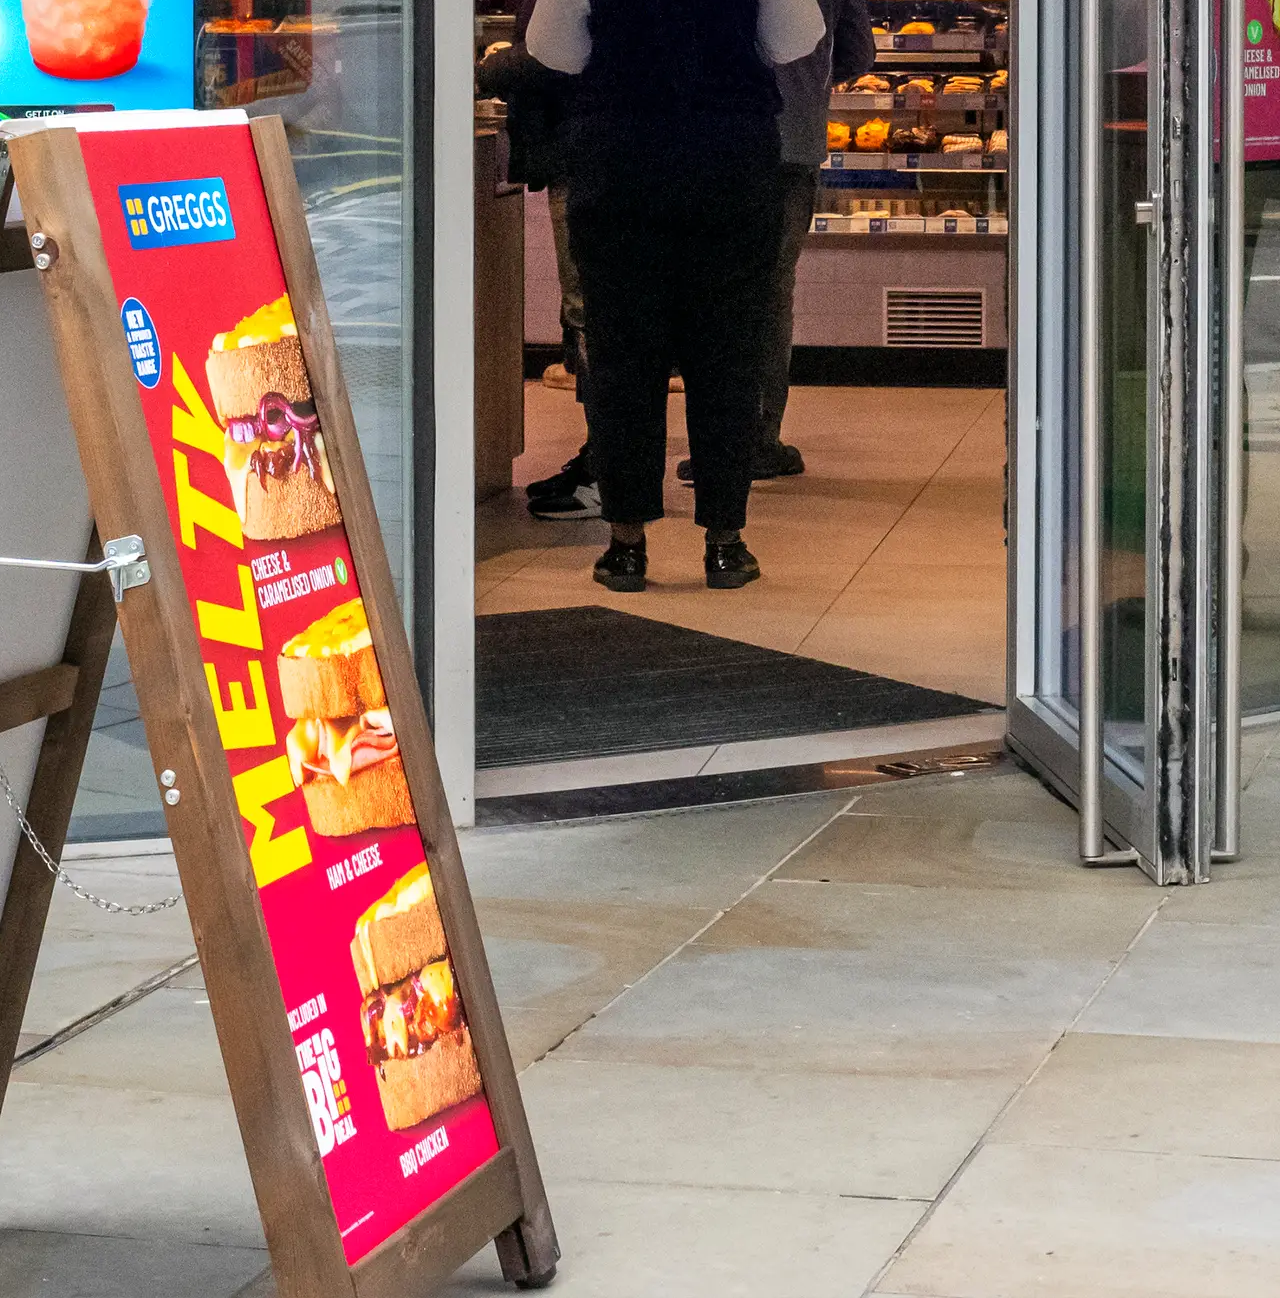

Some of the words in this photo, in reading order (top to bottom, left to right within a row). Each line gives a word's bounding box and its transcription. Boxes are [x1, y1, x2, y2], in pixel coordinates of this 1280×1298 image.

[1266, 50, 1272, 62] &
[147, 190, 227, 234] GREGGS
[126, 309, 144, 330] NEW
[251, 552, 283, 581] CHEESE
[281, 550, 291, 571] &
[258, 572, 311, 609] CARAMELISED
[309, 564, 336, 591] ONION
[172, 351, 313, 890] MELTY
[326, 862, 345, 891] HAM
[344, 857, 355, 874] &
[351, 843, 383, 879] CHEESE
[286, 996, 319, 1033] NCLUDED
[317, 993, 327, 1014] IN
[294, 1038, 317, 1072] THE
[301, 1027, 342, 1158] BIG
[333, 1114, 357, 1146] DEAL
[399, 1146, 419, 1179] BBQ
[415, 1125, 449, 1166] CHICKEN
